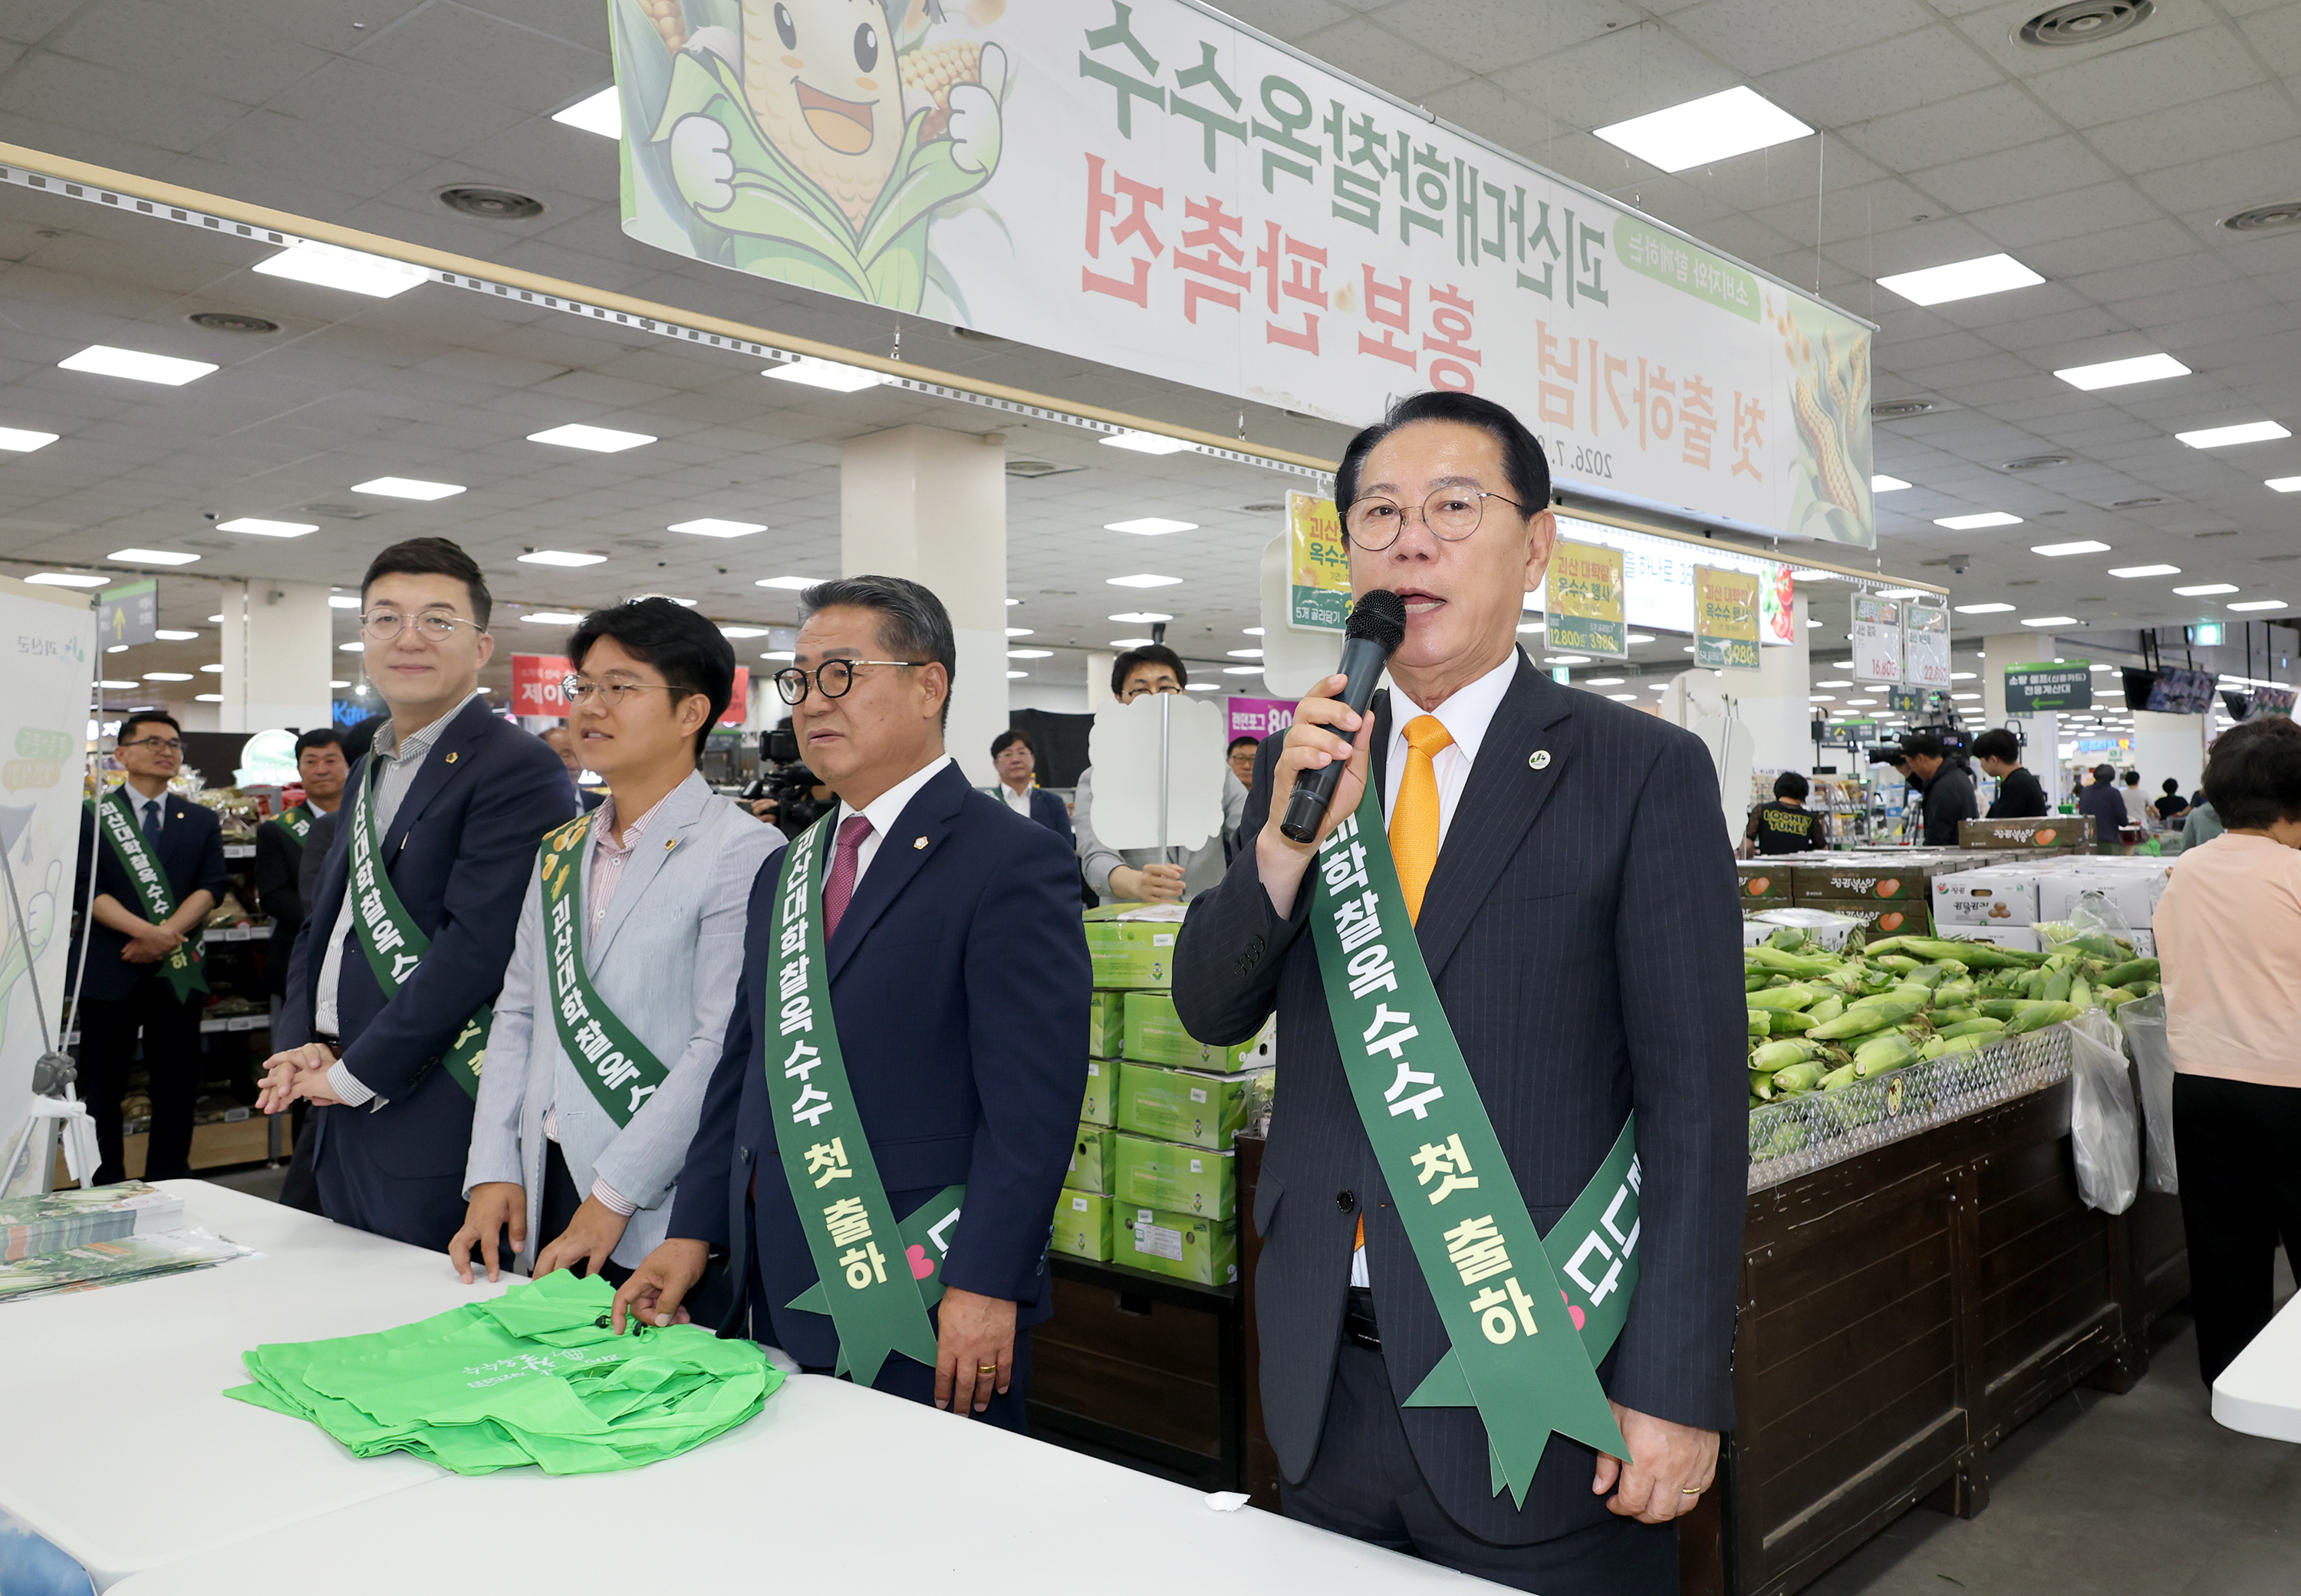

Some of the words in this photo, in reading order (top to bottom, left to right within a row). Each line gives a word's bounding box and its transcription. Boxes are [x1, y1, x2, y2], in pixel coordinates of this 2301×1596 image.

[1309, 517, 1338, 542] 괴산
[1557, 556, 1578, 577] 괴산
[1582, 561, 1610, 582] 대학찰
[1559, 577, 1589, 598] 옥수수
[1592, 583, 1611, 602] 행사
[1295, 607, 1309, 620] 5개
[1707, 602, 1730, 621] 옥수수
[1763, 809, 1812, 828] LOONEY
[1769, 820, 1808, 837] TUNES
[779, 820, 833, 1127] 괴산대학찰옥수수
[804, 1136, 853, 1191] 첫
[1411, 1132, 1479, 1206] 첫
[823, 1196, 887, 1291] 출하
[1443, 1215, 1539, 1345] 출하
